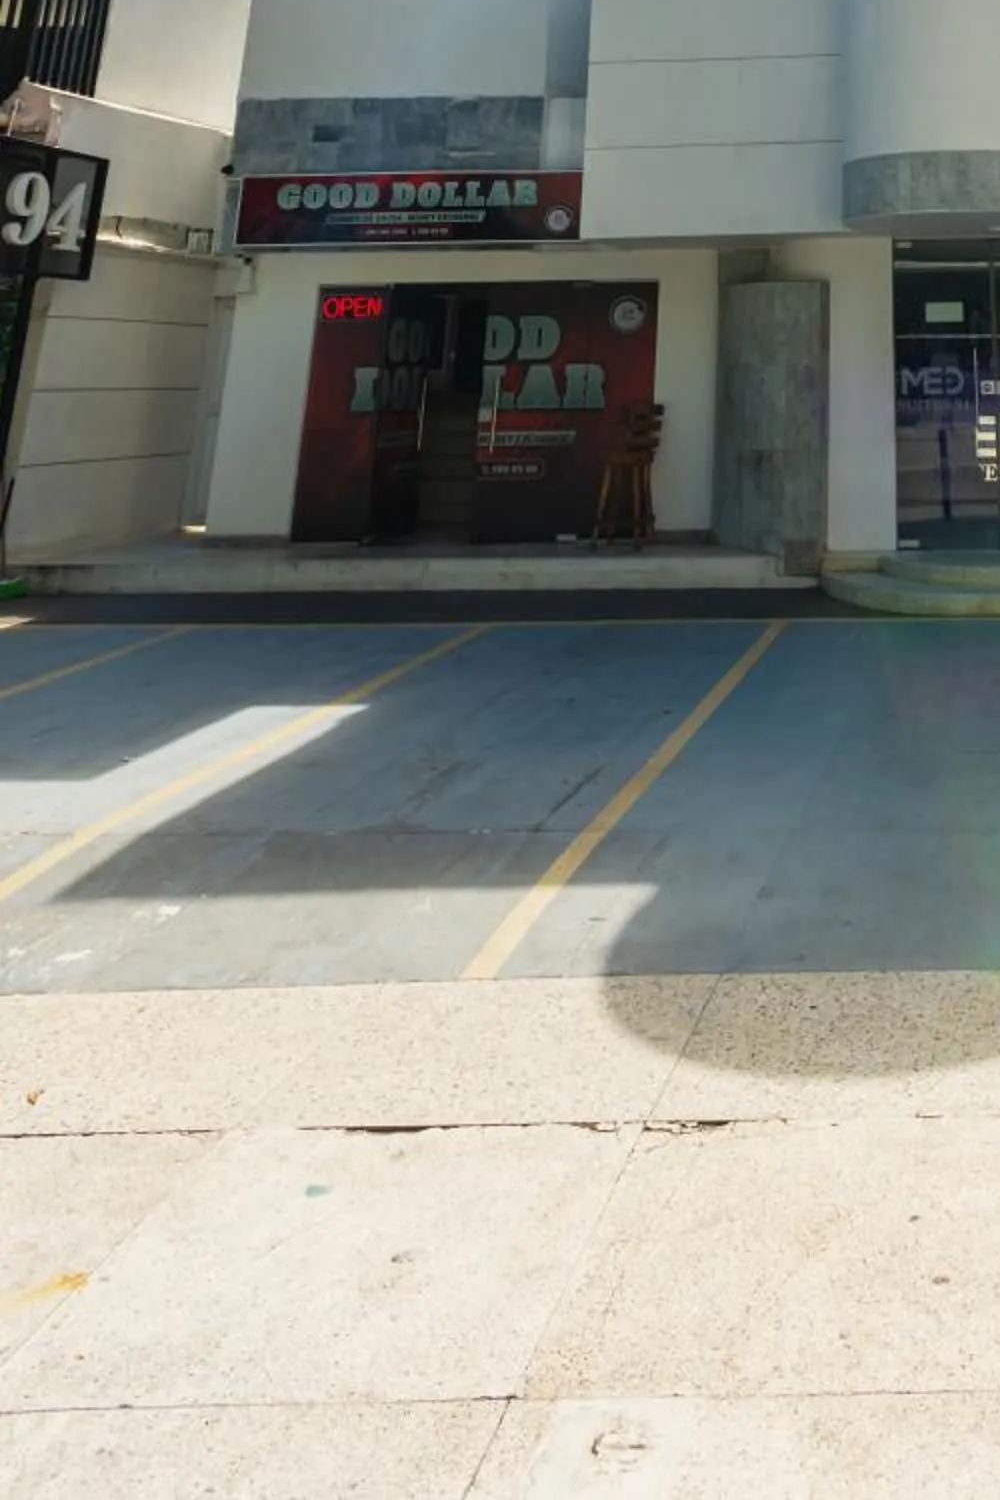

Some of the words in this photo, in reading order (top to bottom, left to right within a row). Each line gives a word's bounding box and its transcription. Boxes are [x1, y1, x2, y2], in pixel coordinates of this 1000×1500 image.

[276, 182, 380, 210] GOOD
[391, 179, 538, 208] DOLLAR
[1, 171, 87, 253] 94
[322, 295, 383, 320] OPEN
